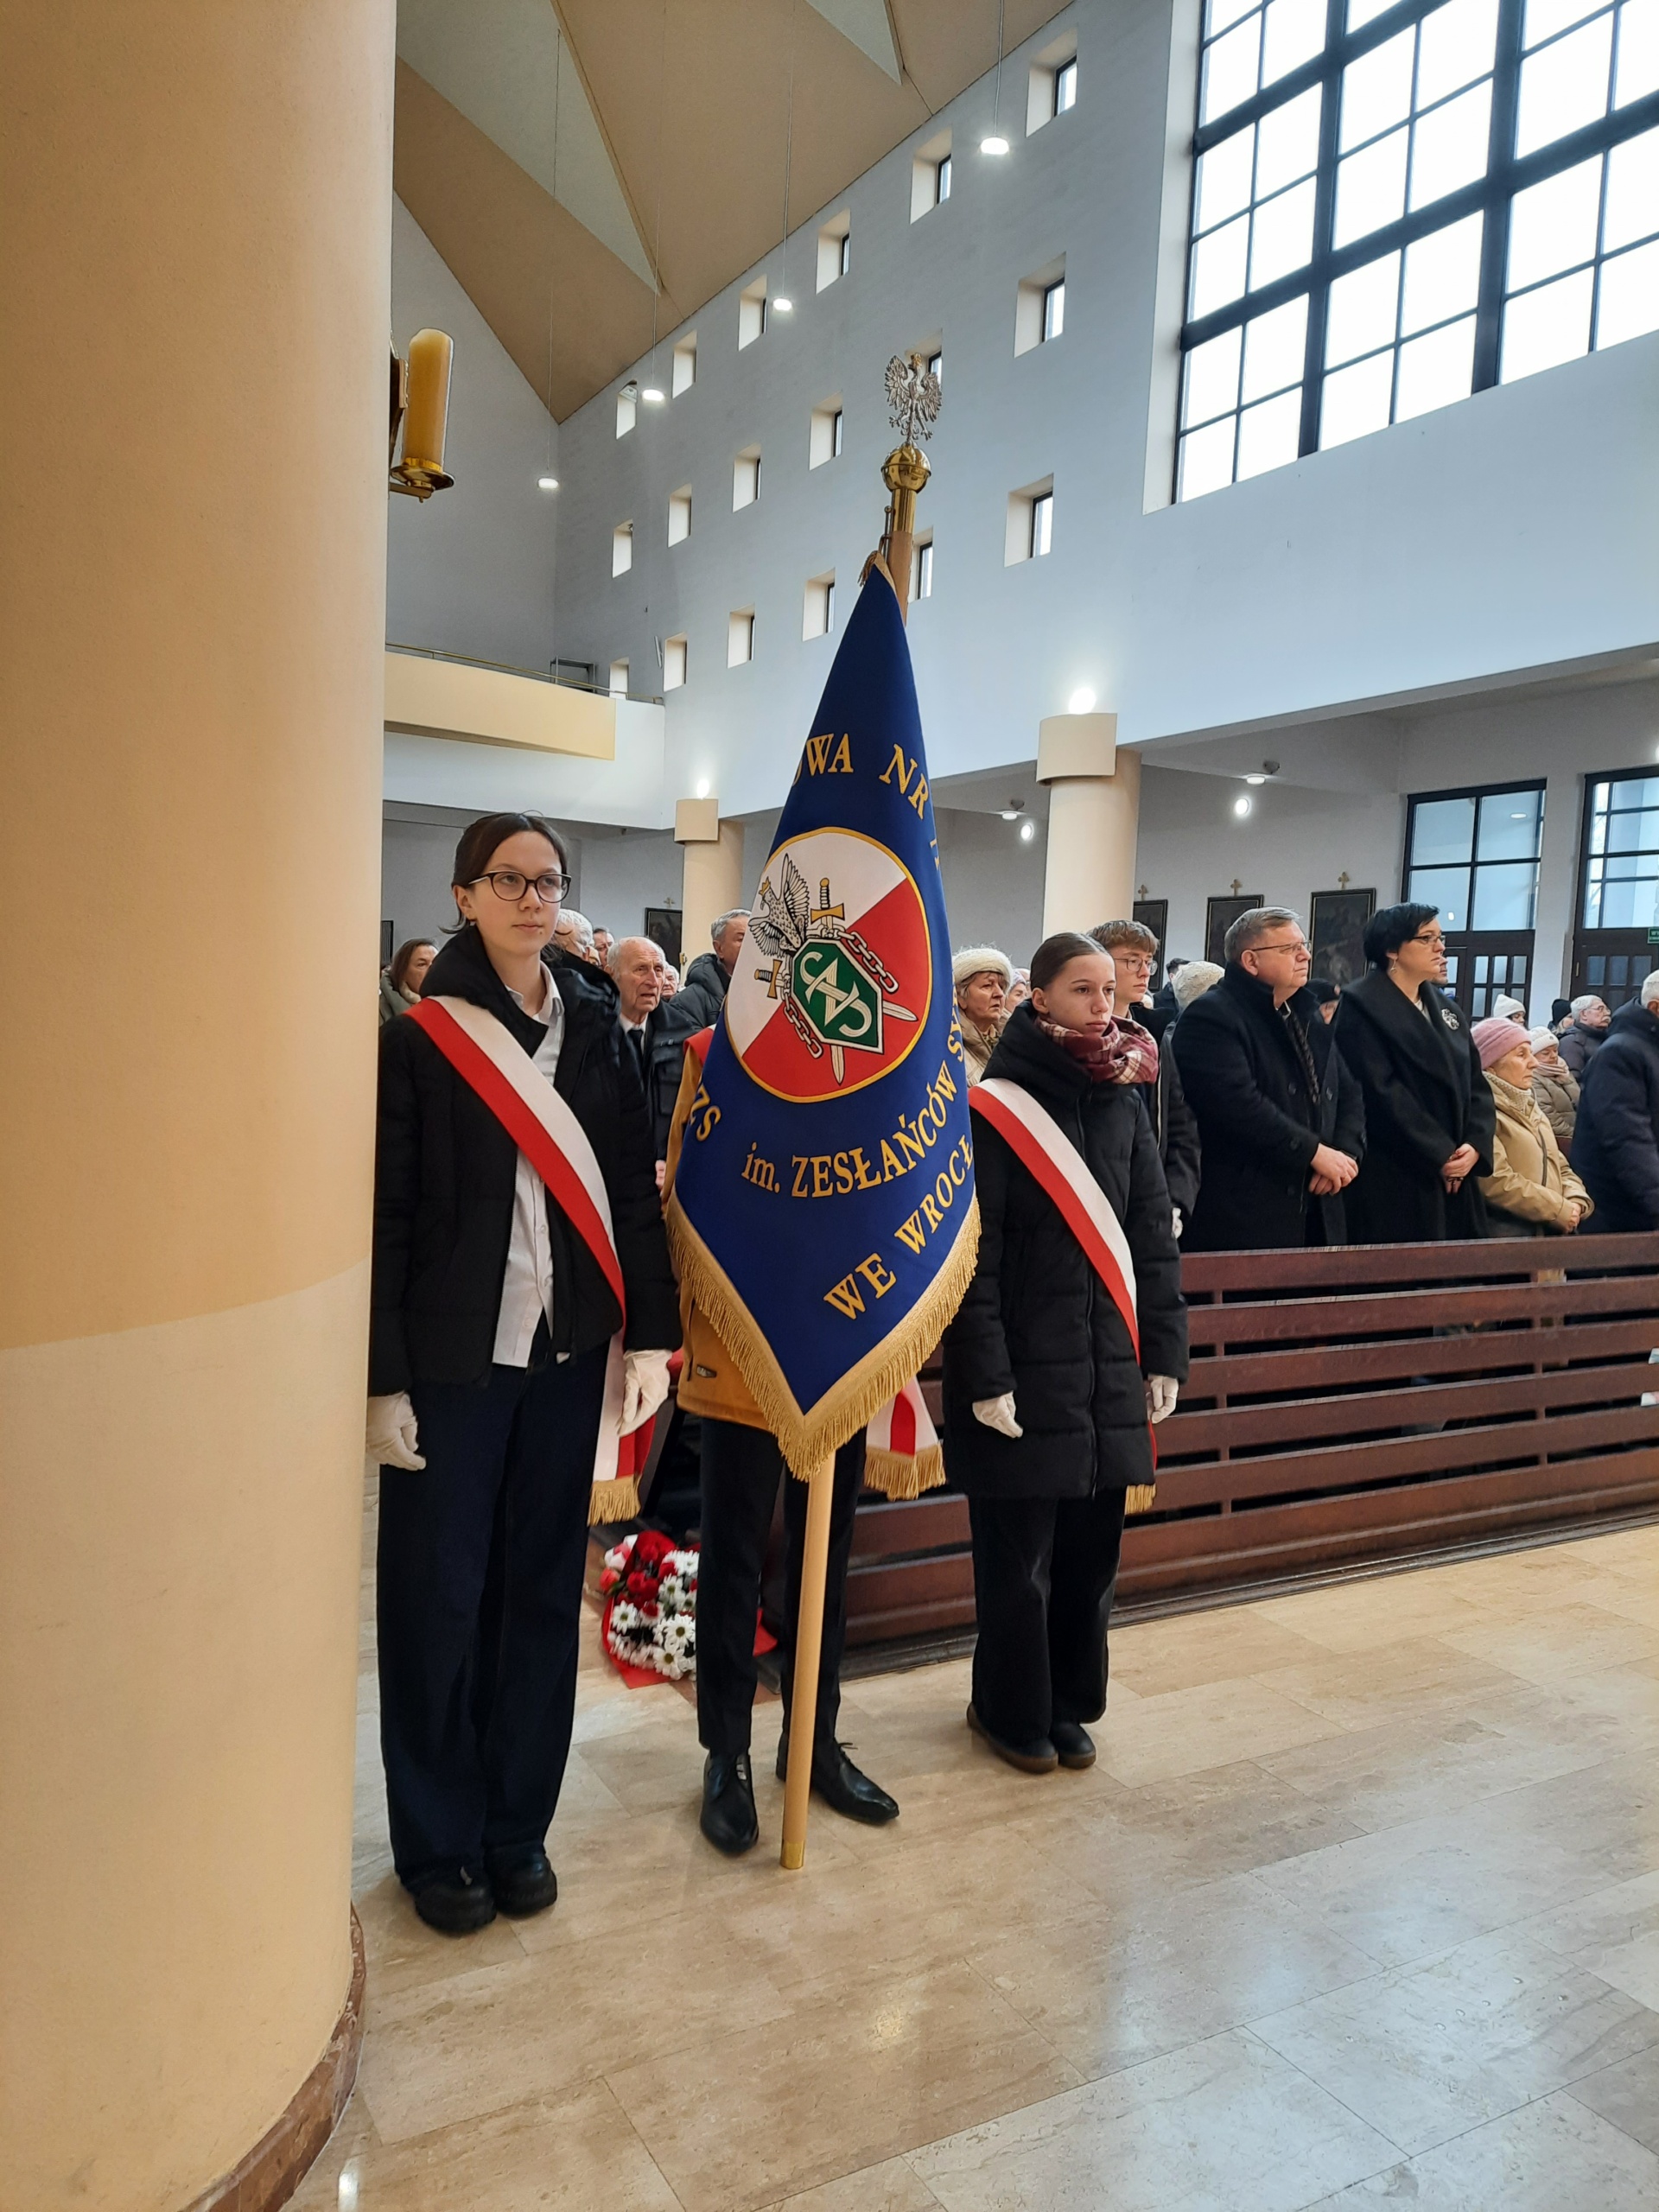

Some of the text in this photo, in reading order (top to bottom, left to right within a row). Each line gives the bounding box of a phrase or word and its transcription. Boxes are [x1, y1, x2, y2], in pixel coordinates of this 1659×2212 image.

[791, 732, 930, 820] WA NR
[741, 1141, 781, 1193] im.
[791, 1059, 957, 1198] ZESŁAŃCÓW
[823, 1252, 897, 1320] WE
